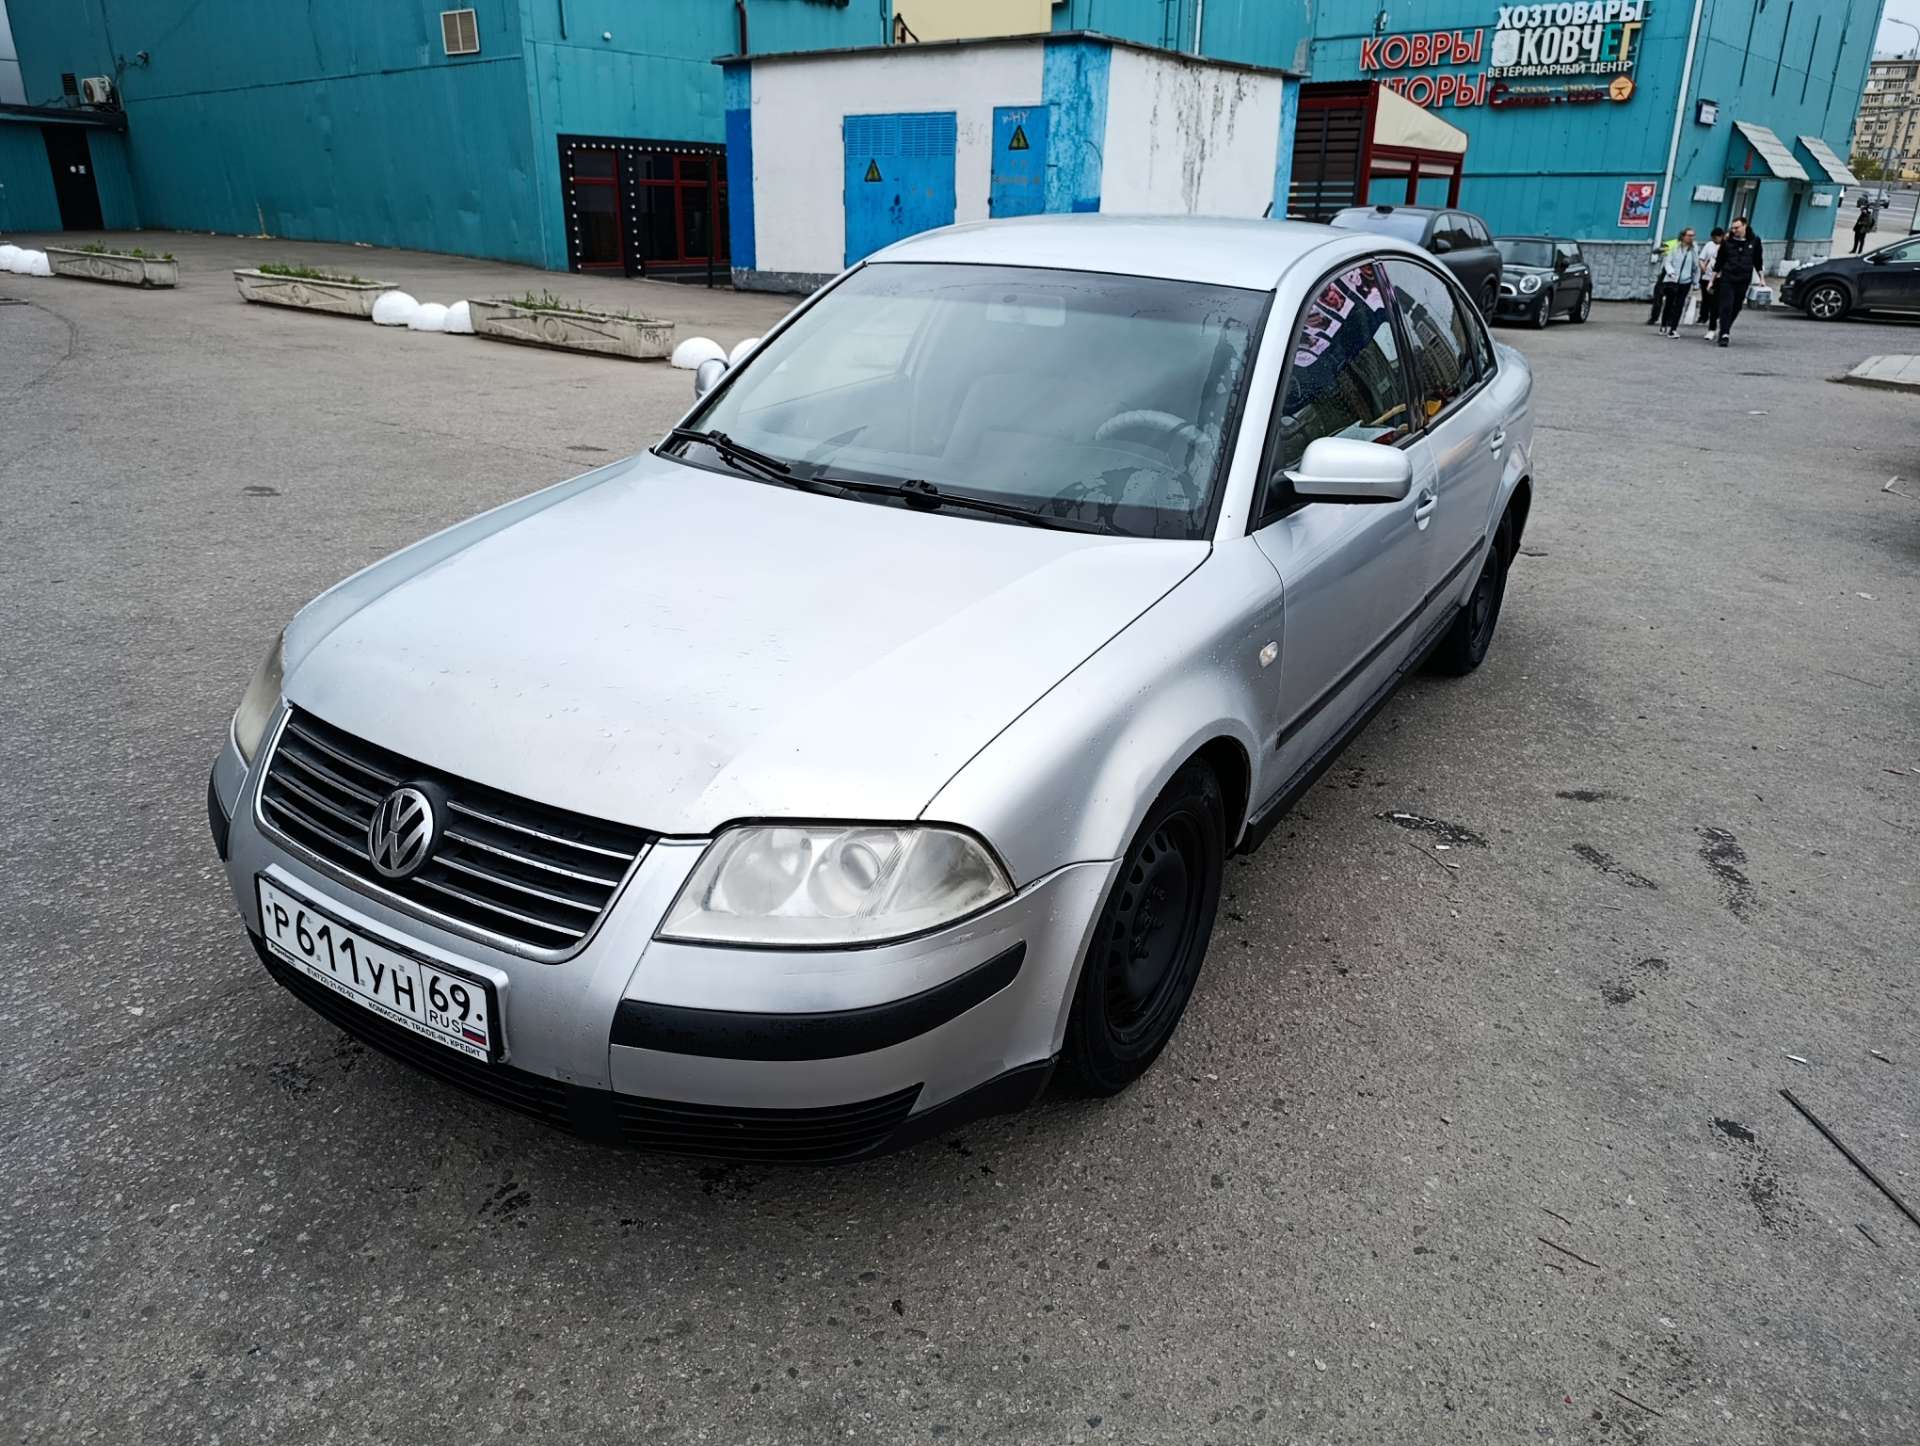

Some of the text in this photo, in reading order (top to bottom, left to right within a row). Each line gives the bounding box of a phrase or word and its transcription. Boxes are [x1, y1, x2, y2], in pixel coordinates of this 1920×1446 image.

[1495, 0, 1645, 29] ХОЗТОВАРЫ
[1359, 28, 1485, 71] КОВРЫ
[1520, 23, 1643, 65] КОВЧЕГ
[1487, 61, 1634, 78] ВЕТЕРИНАРНЫЙ ЦЕНТР
[1374, 72, 1487, 108] ТОРЫ
[428, 975, 471, 1021] 69
[429, 1009, 461, 1033] RUS
[449, 1038, 481, 1058] КРЕДИТ
